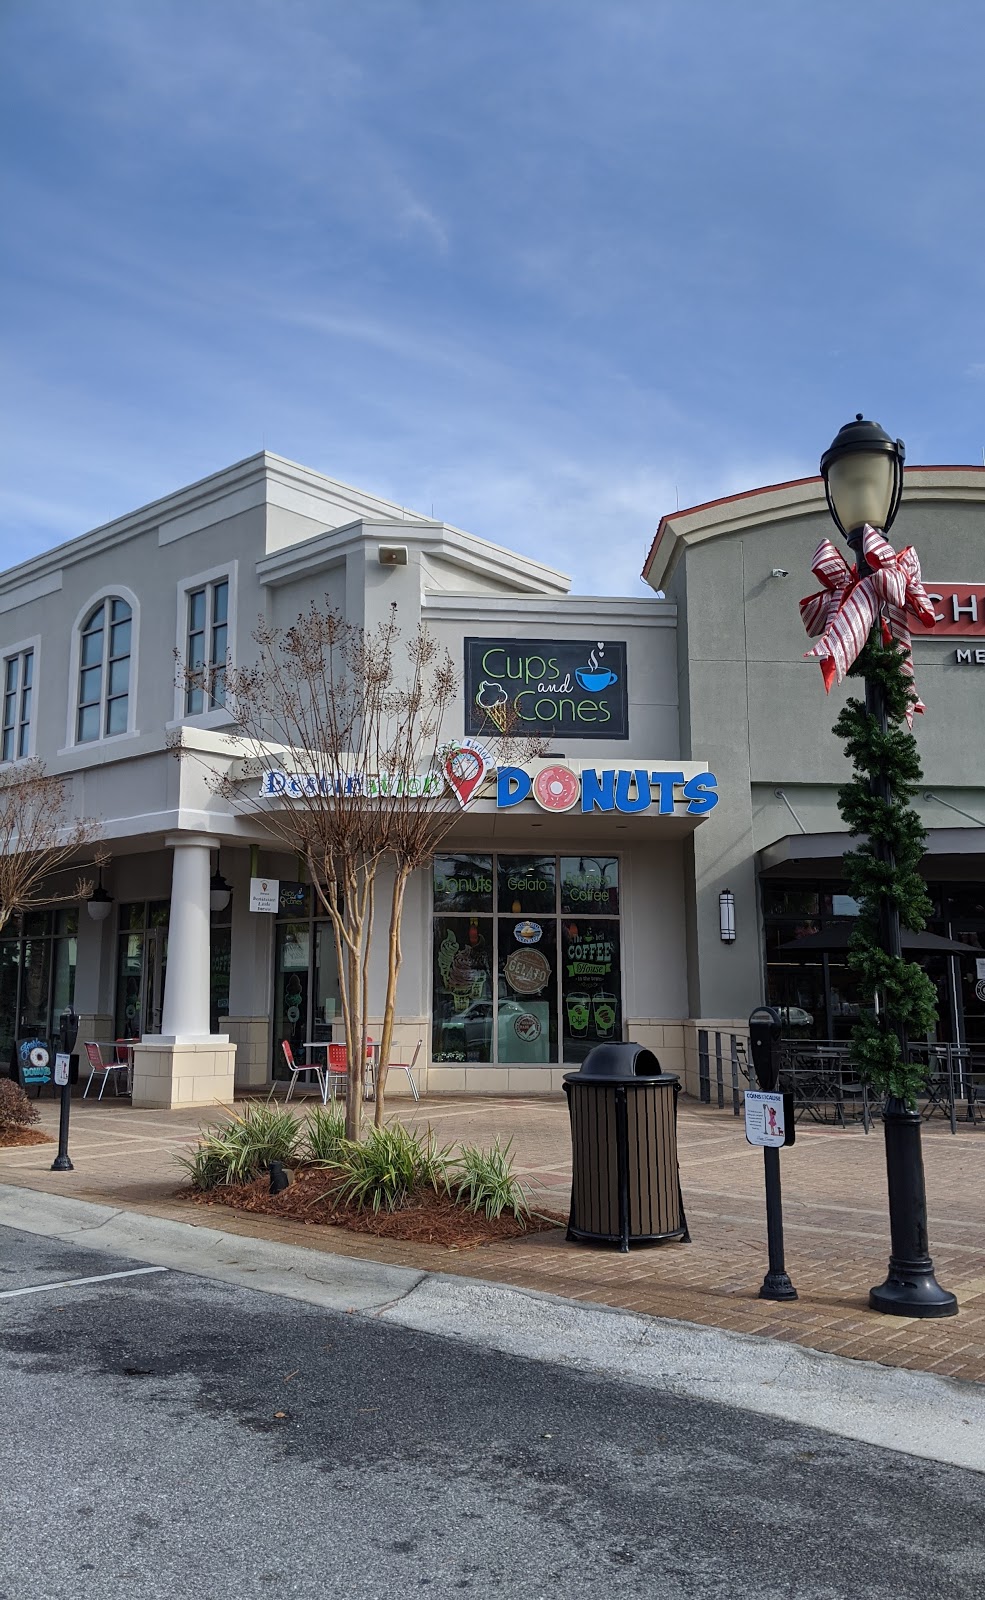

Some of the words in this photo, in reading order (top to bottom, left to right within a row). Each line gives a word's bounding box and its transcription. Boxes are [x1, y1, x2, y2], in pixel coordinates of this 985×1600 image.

[482, 648, 560, 684] Cups
[537, 673, 574, 694] and
[514, 690, 611, 722] Cones
[433, 875, 492, 893] Donuts
[507, 876, 547, 891] Gelato
[569, 887, 609, 902] Coffee
[568, 942, 612, 963] COFFEE
[508, 960, 547, 982] GELATO
[576, 962, 604, 974] House
